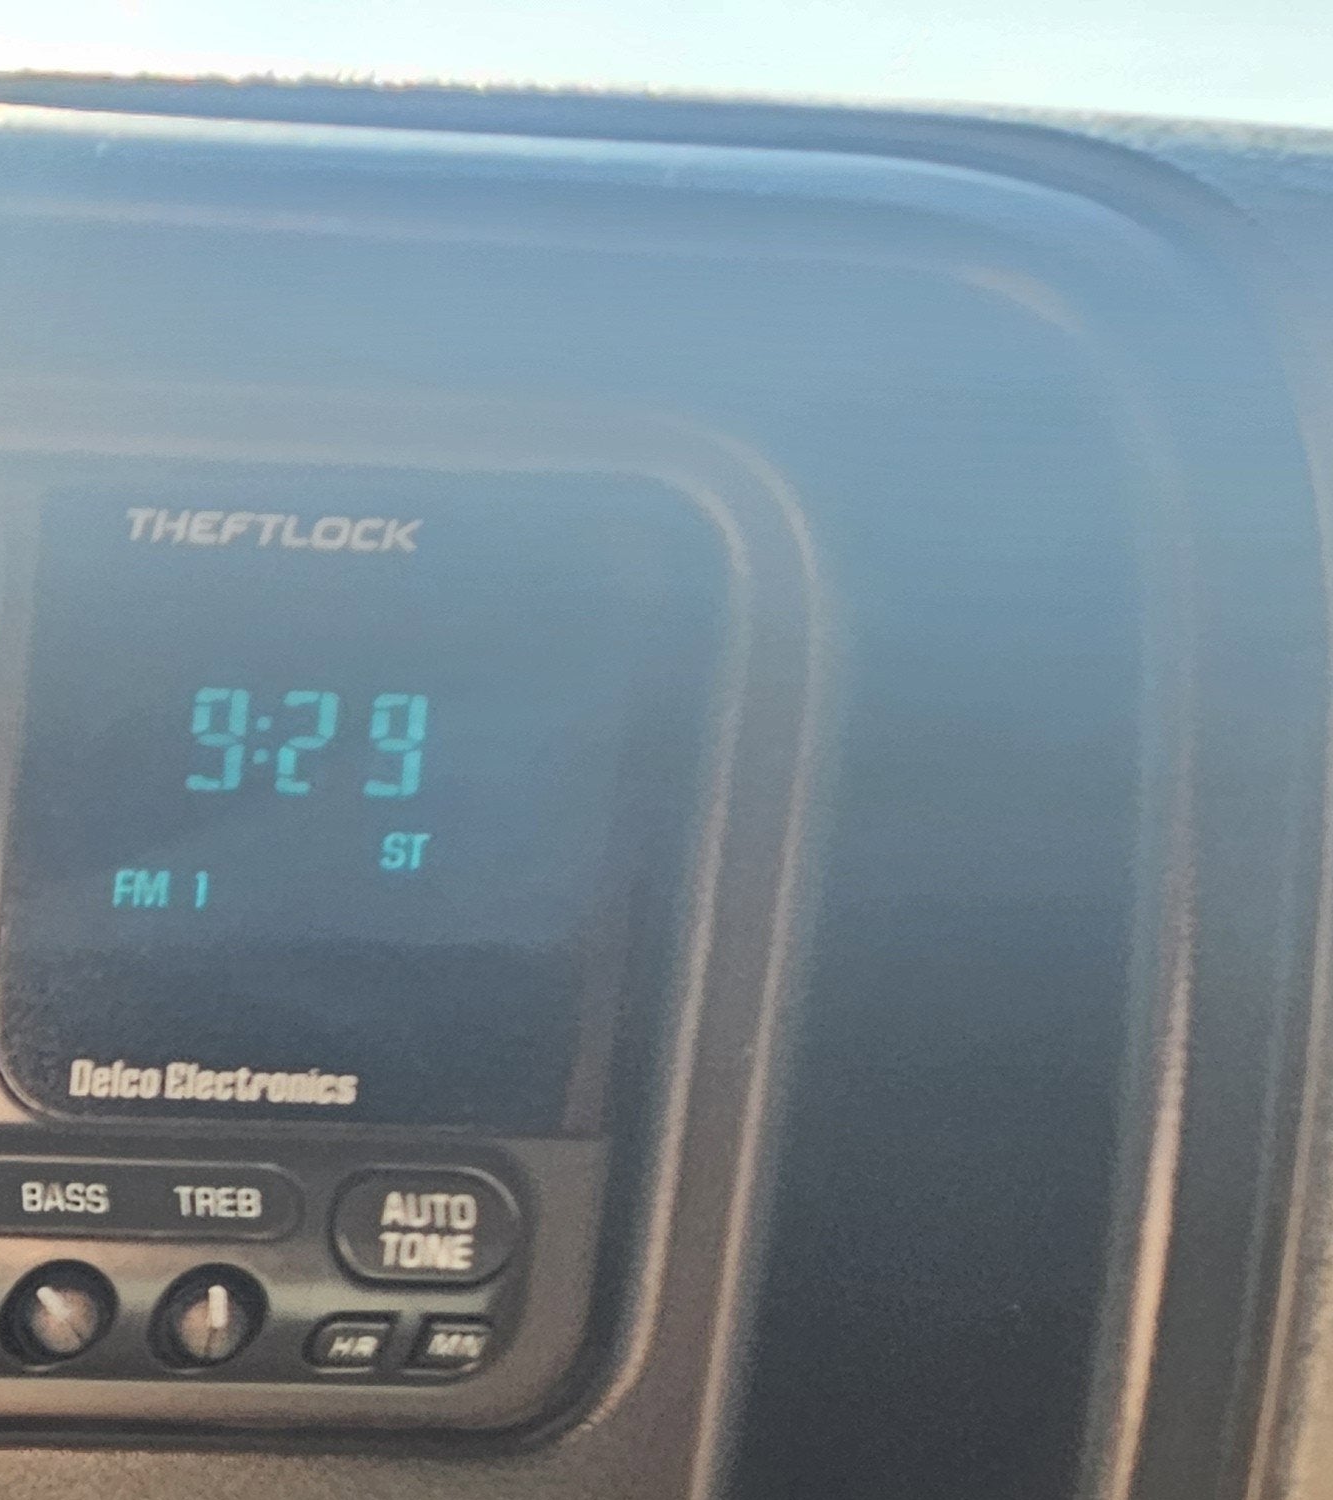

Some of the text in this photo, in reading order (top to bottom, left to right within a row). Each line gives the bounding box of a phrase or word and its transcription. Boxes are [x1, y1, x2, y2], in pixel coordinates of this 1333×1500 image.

[126, 506, 425, 553] THEFTLOCK
[185, 686, 430, 797] 9:29
[379, 832, 431, 871] ST
[111, 868, 210, 909] FM 1
[67, 1058, 359, 1105] Delco Electronics
[21, 1180, 110, 1216] BASS
[173, 1184, 263, 1219] TREB
[380, 1190, 478, 1230] AUTO
[378, 1231, 476, 1270] TONE
[327, 1335, 379, 1358] HR
